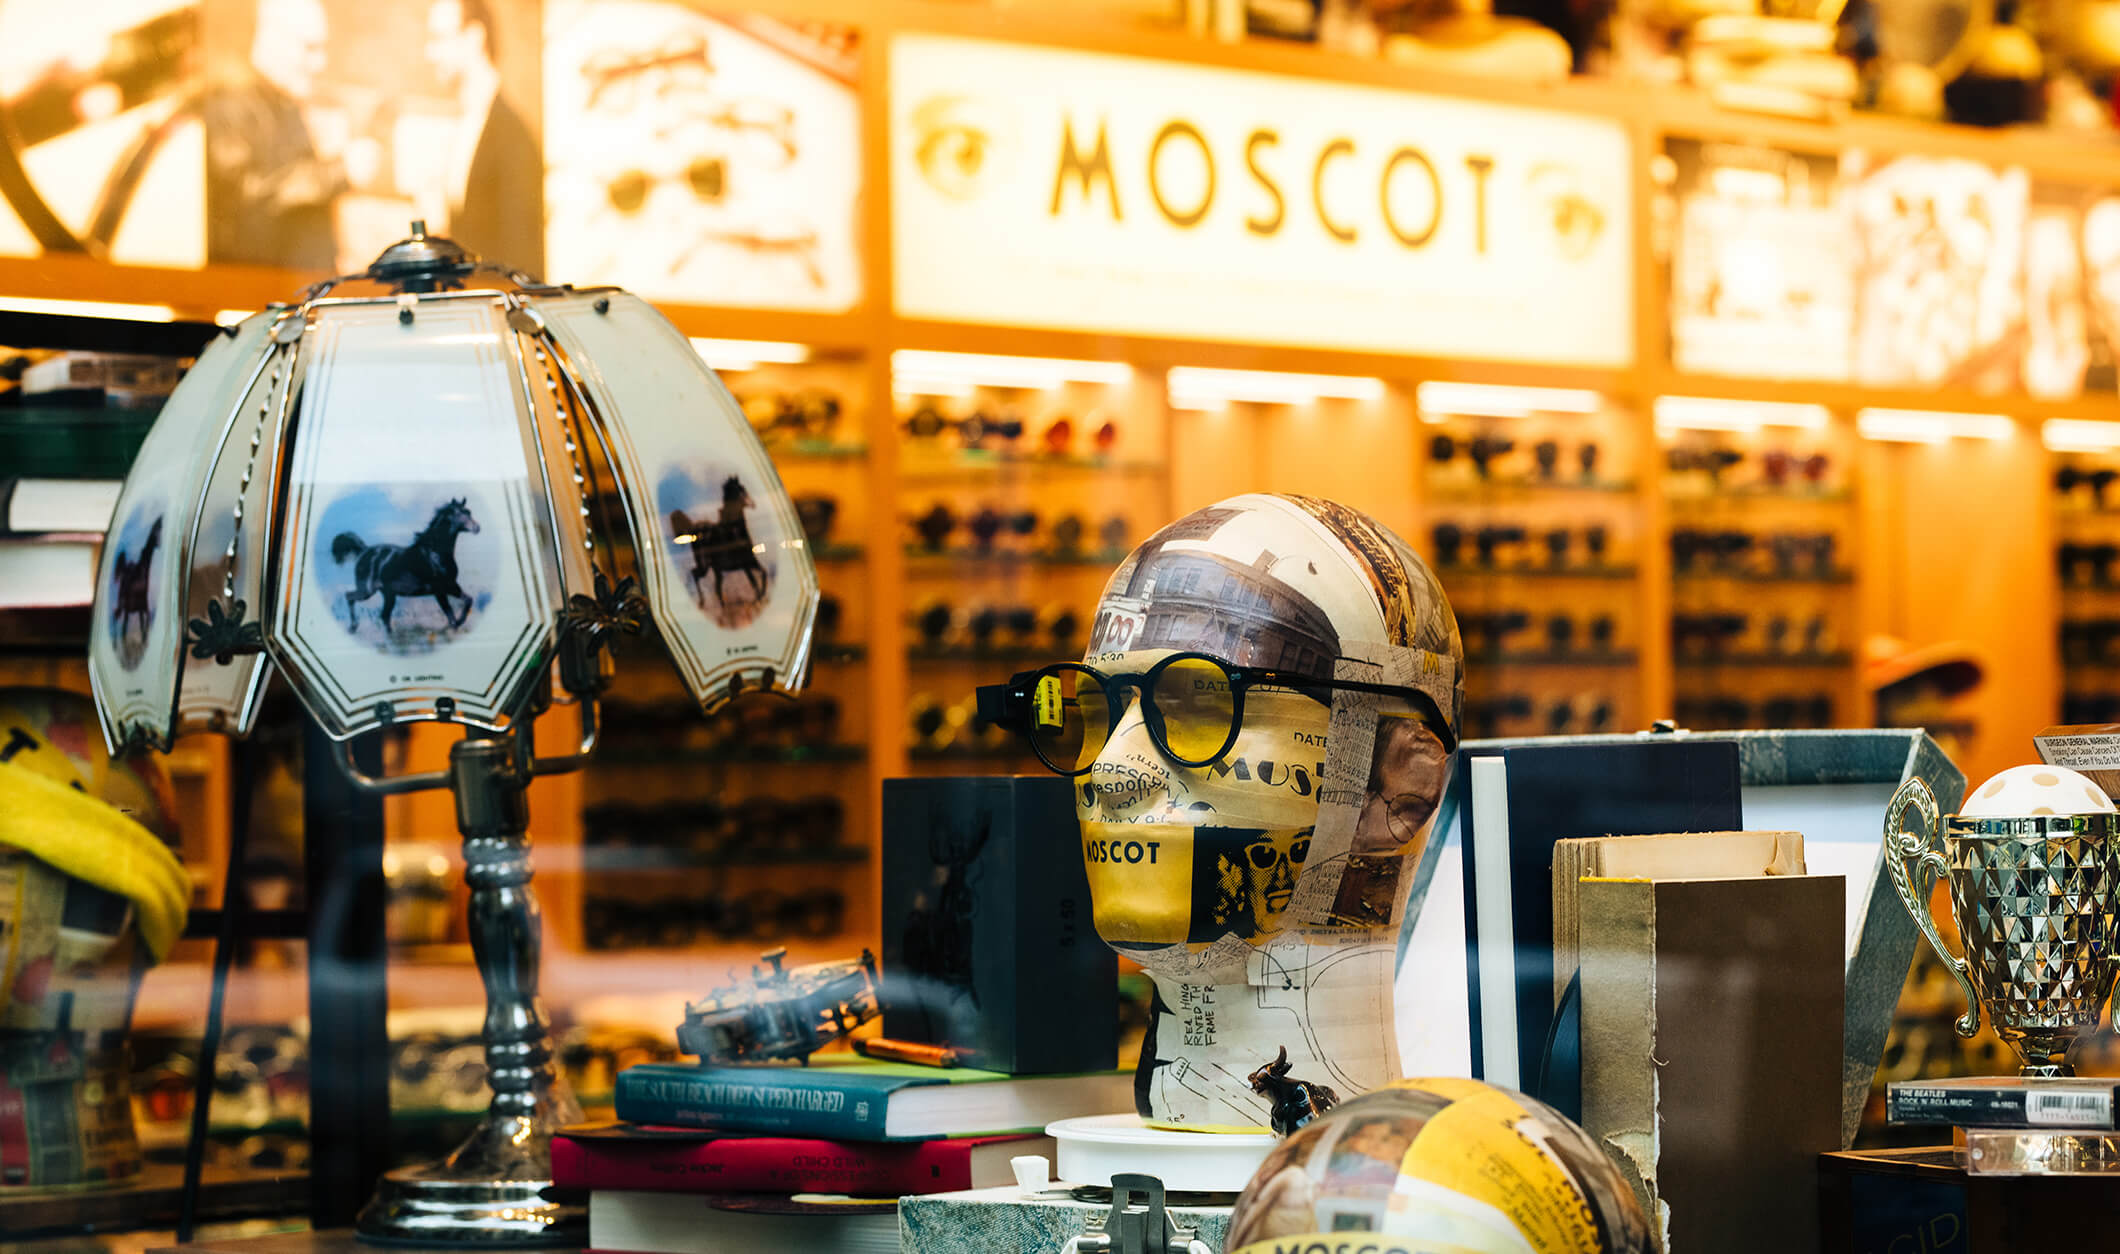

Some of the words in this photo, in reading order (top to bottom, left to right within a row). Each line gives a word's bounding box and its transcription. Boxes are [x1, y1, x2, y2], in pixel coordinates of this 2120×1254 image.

[1049, 107, 1494, 253] MOSCOT
[1914, 1090, 1947, 1098] BEATLES
[1929, 1098, 1948, 1106] ROLL
[1950, 1099, 1973, 1107] MUSIC
